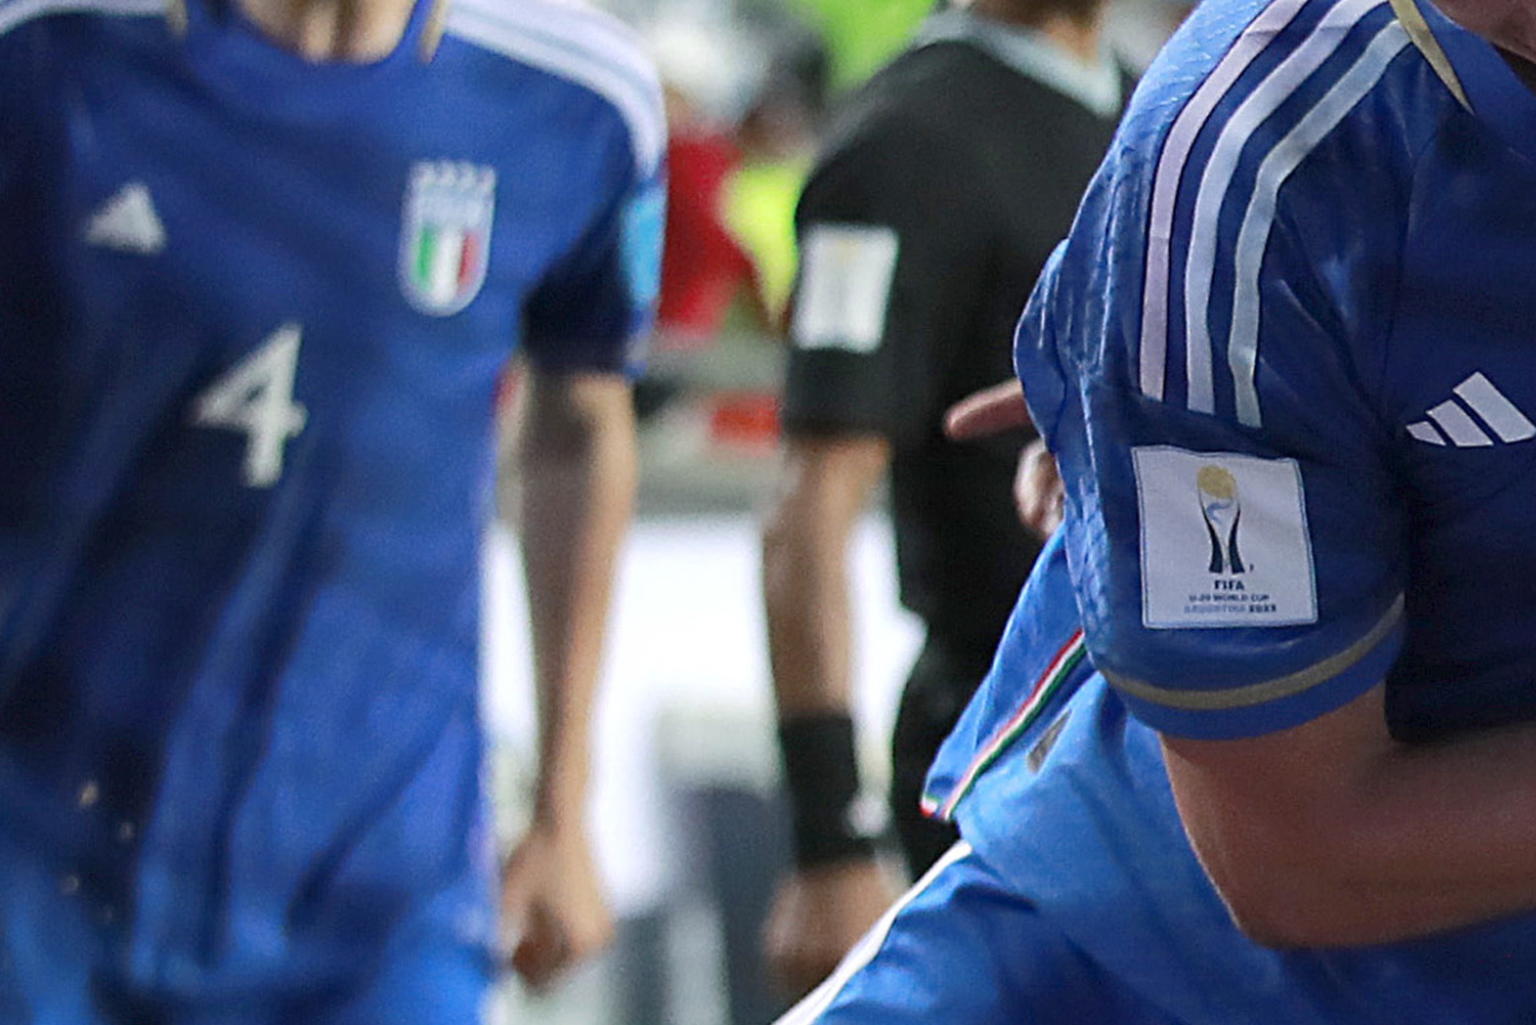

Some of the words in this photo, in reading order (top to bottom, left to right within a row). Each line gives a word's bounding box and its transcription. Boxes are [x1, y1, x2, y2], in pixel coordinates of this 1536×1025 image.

[194, 322, 308, 488] 4
[1214, 579, 1246, 590] FIFA
[1213, 594, 1249, 602] WORLD
[1251, 594, 1270, 602] CUP
